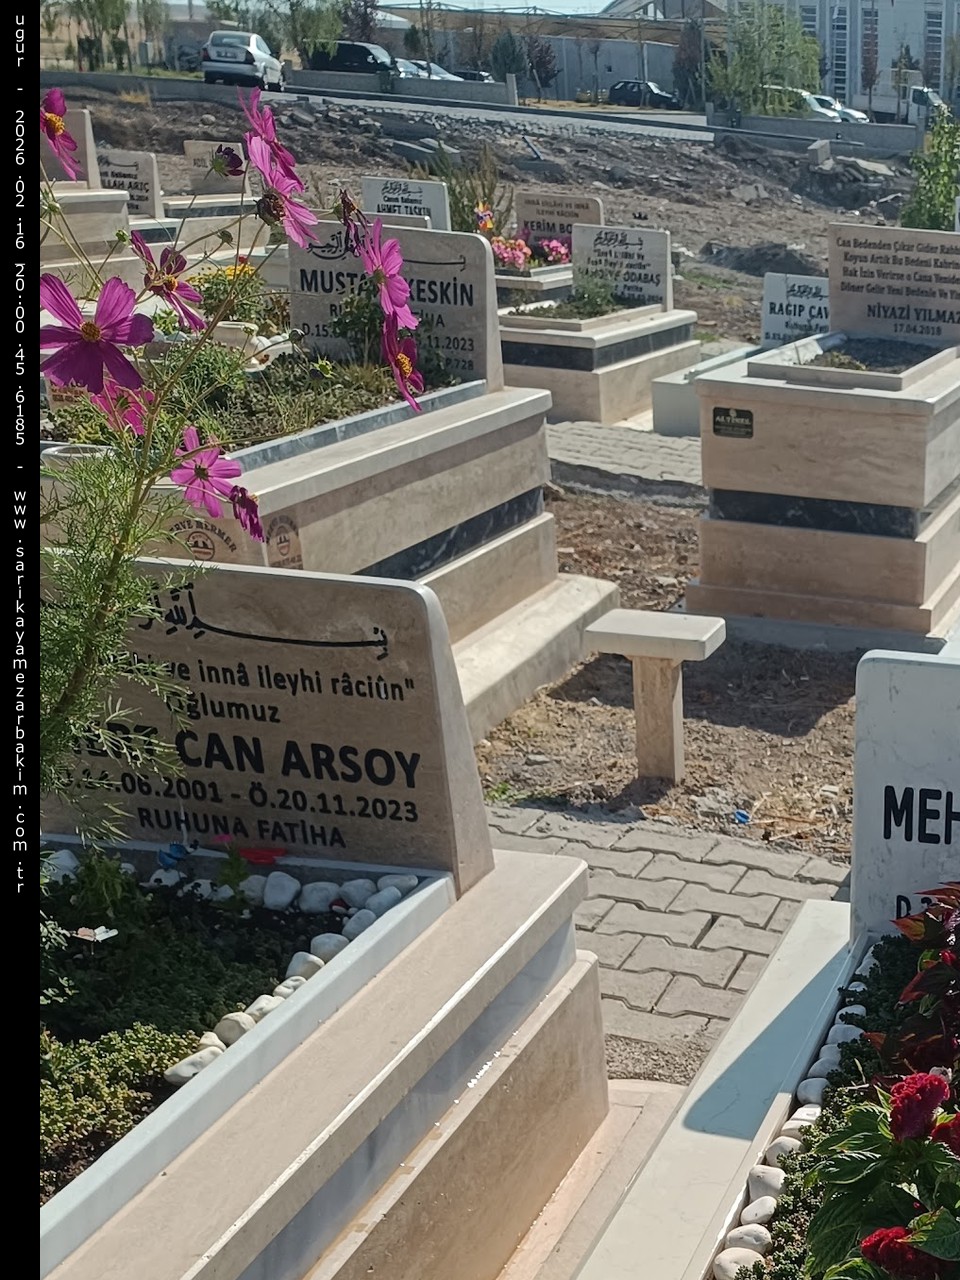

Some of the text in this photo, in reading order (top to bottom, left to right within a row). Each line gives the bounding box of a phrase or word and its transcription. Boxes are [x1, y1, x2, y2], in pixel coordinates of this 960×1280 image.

[769, 301, 805, 317] RAGIP
[866, 302, 911, 321] NİYAZİ
[199, 659, 250, 687] innâ
[257, 664, 323, 696] ileyhi
[175, 730, 421, 789] CAN ARSOY
[249, 781, 419, 824] Ö.20.11.2023
[139, 806, 347, 848] RUHUNA FATİHA
